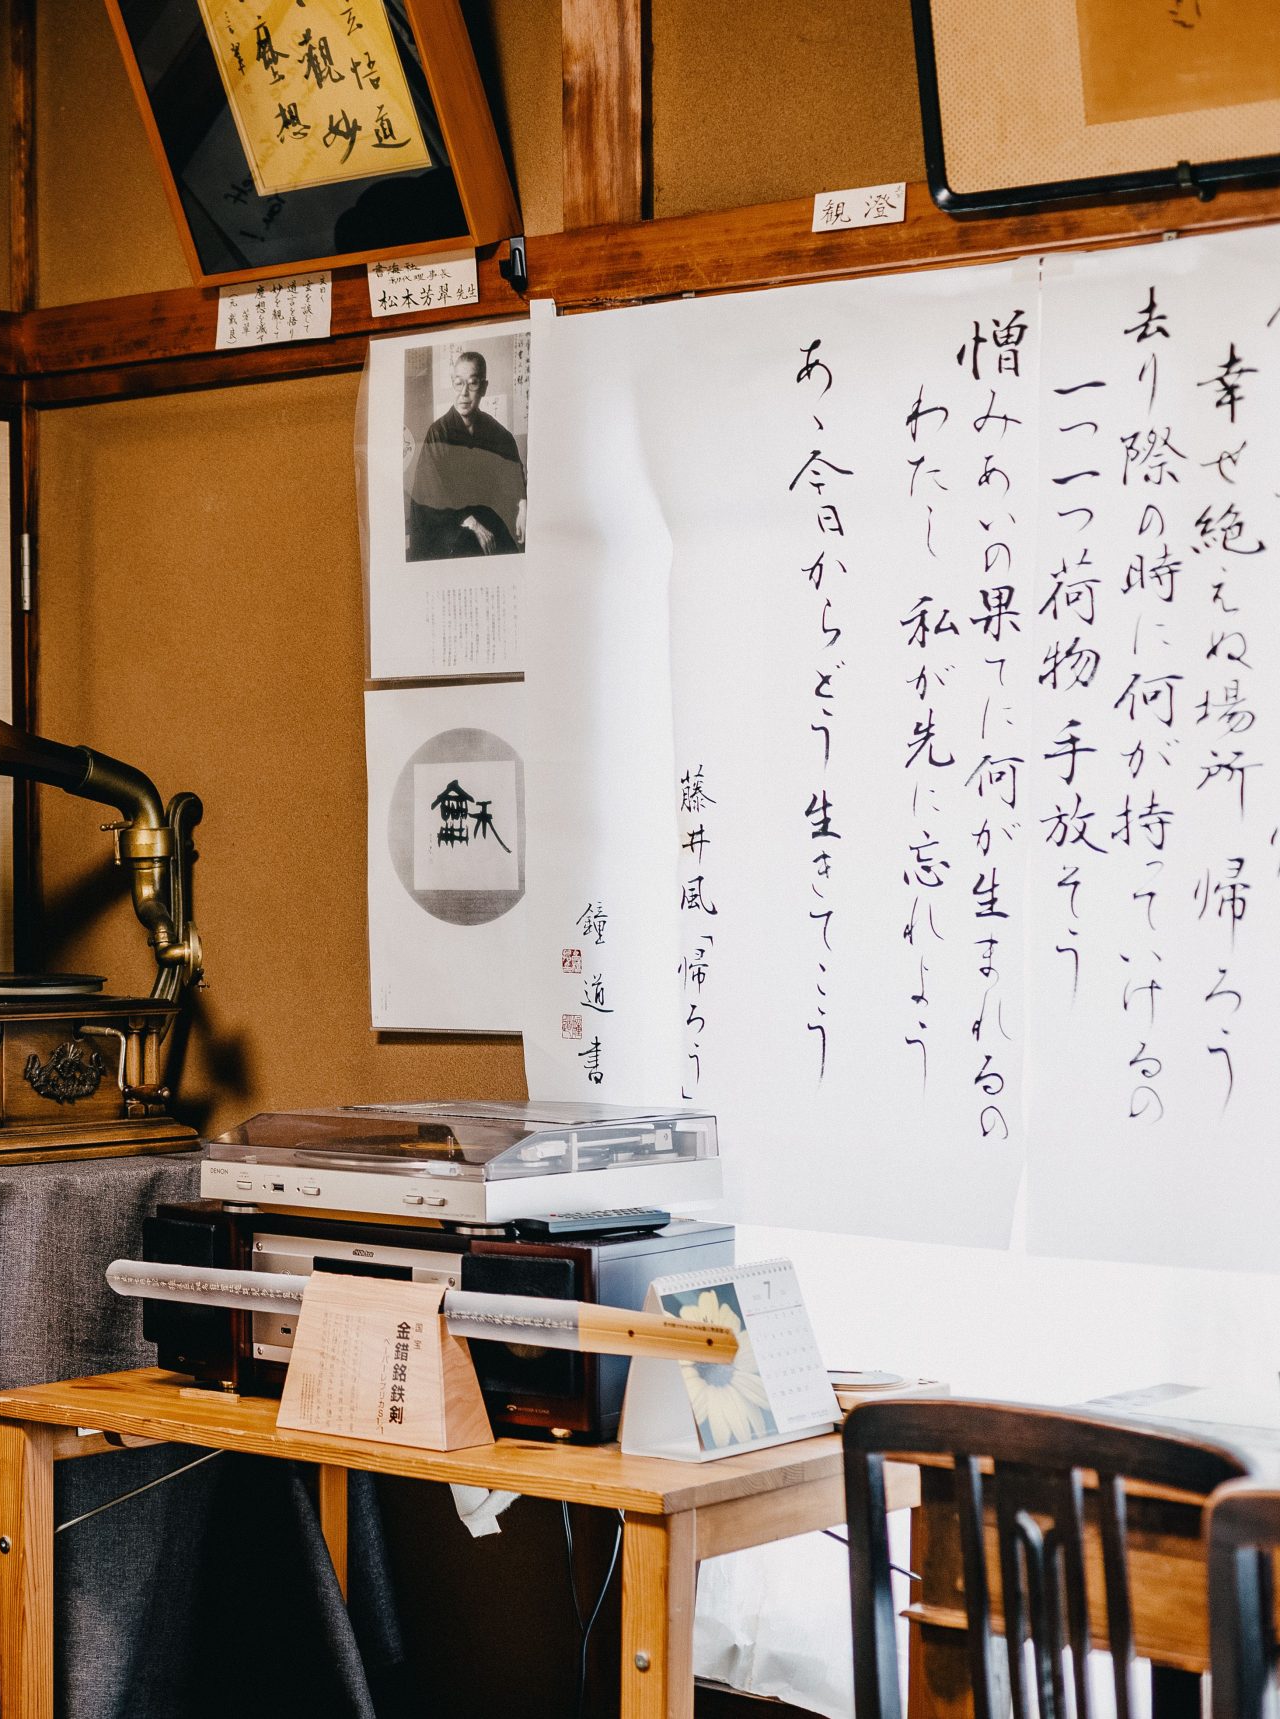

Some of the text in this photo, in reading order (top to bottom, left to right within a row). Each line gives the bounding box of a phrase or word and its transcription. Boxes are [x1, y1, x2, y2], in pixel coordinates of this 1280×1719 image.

[389, 1321, 411, 1425] 金錯銘鉄剣
